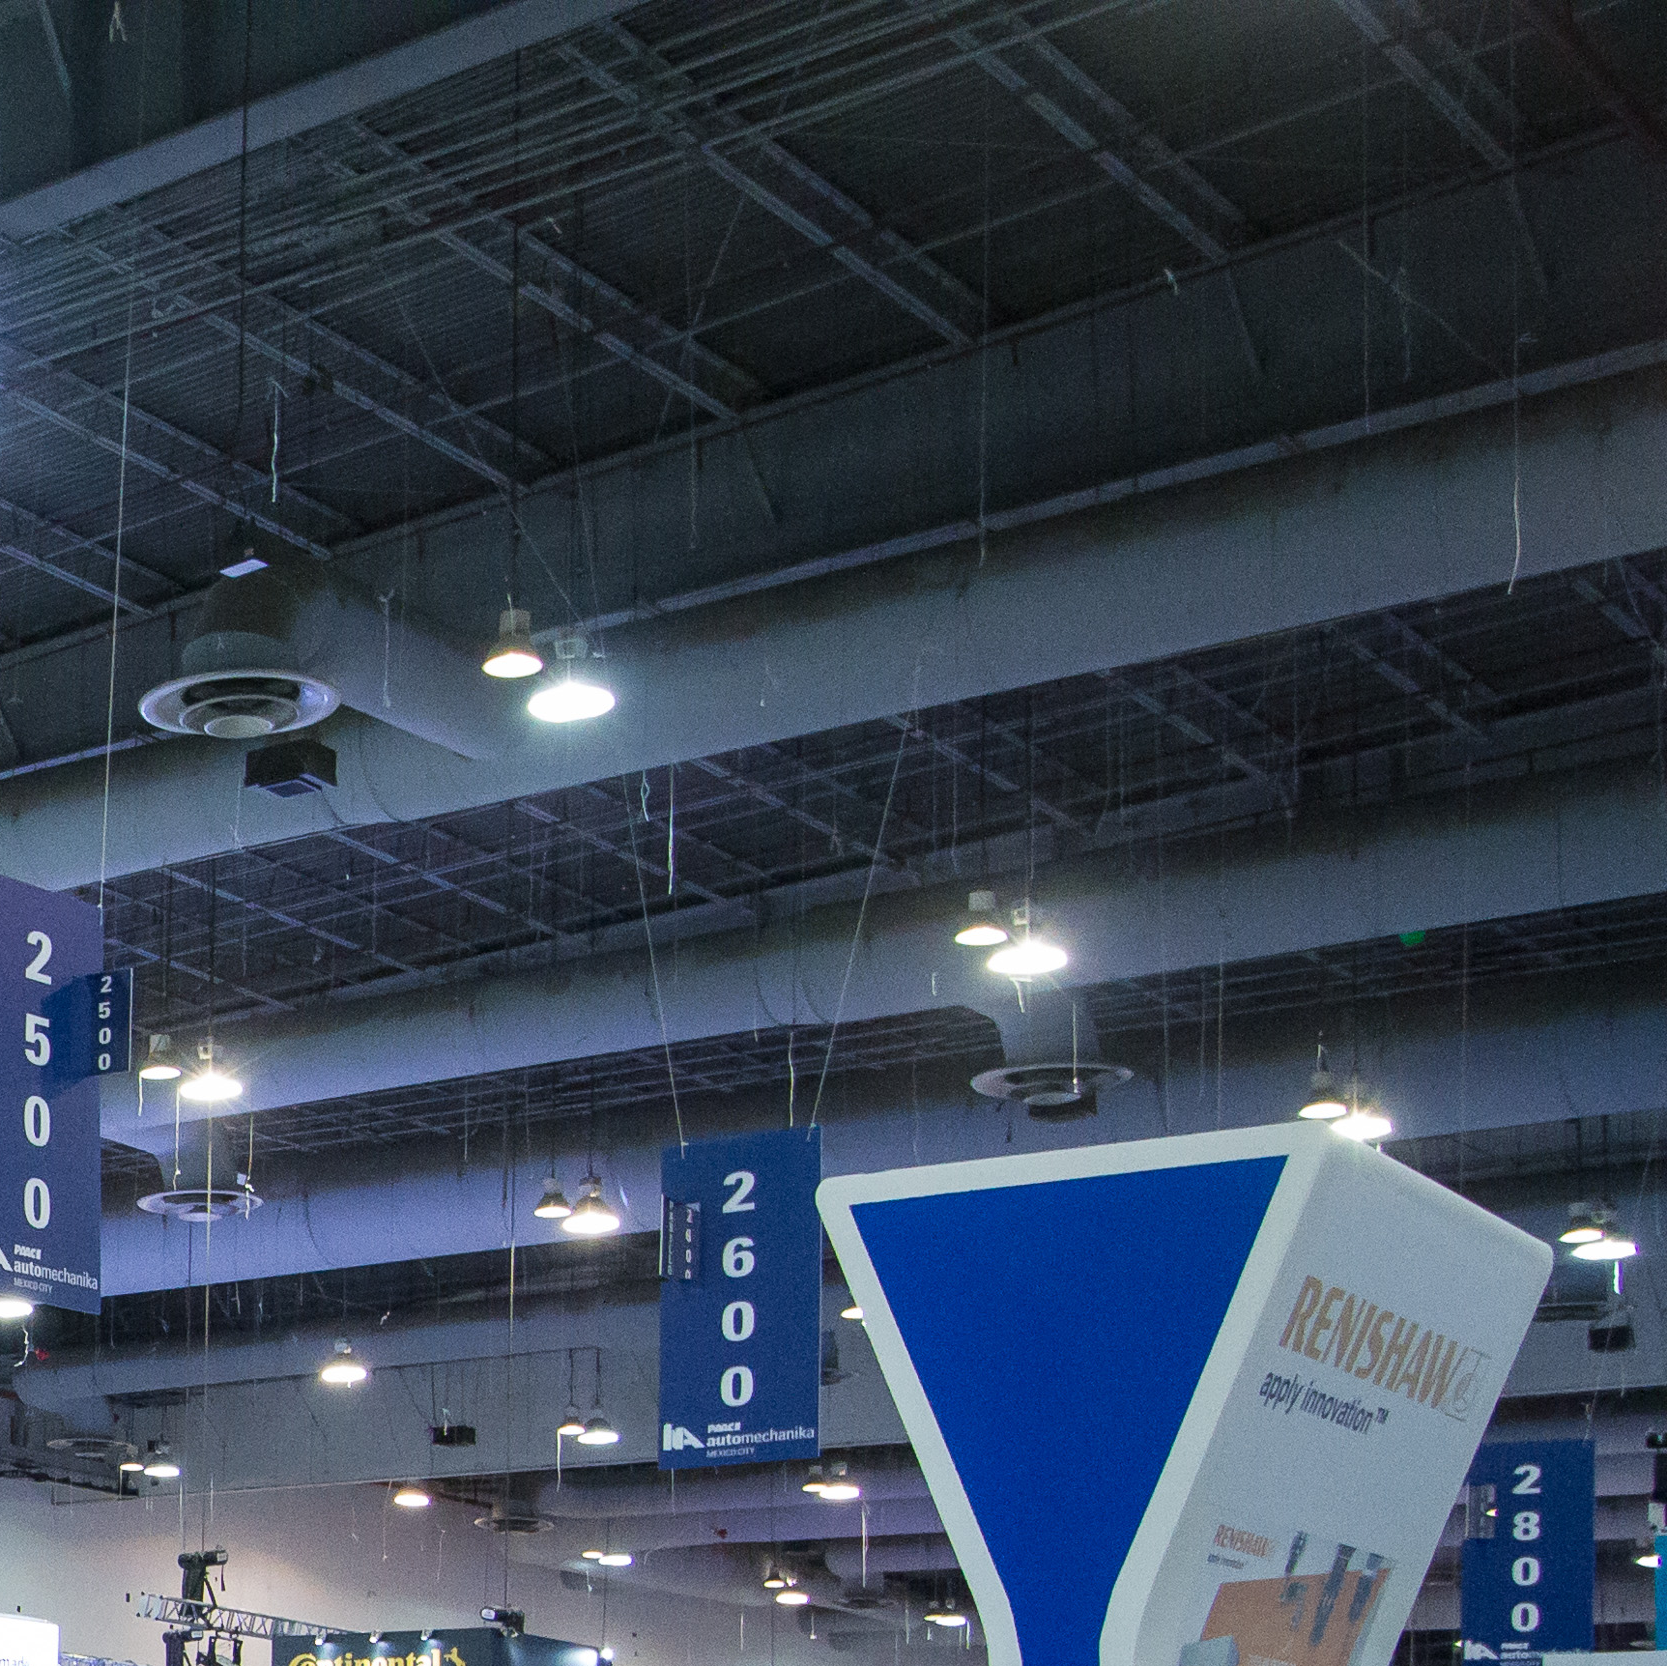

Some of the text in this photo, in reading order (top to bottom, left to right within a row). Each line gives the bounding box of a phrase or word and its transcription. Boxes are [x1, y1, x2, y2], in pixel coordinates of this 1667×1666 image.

[24, 930, 53, 1230] 2500
[97, 976, 113, 1071] 2500
[14, 1260, 98, 1290] automechanika
[721, 1170, 755, 1407] 2600
[1259, 1371, 1304, 1415] apply
[1279, 1274, 1459, 1409] RENISHAW
[706, 1425, 816, 1448] automechanika
[1511, 1464, 1542, 1633] 2800
